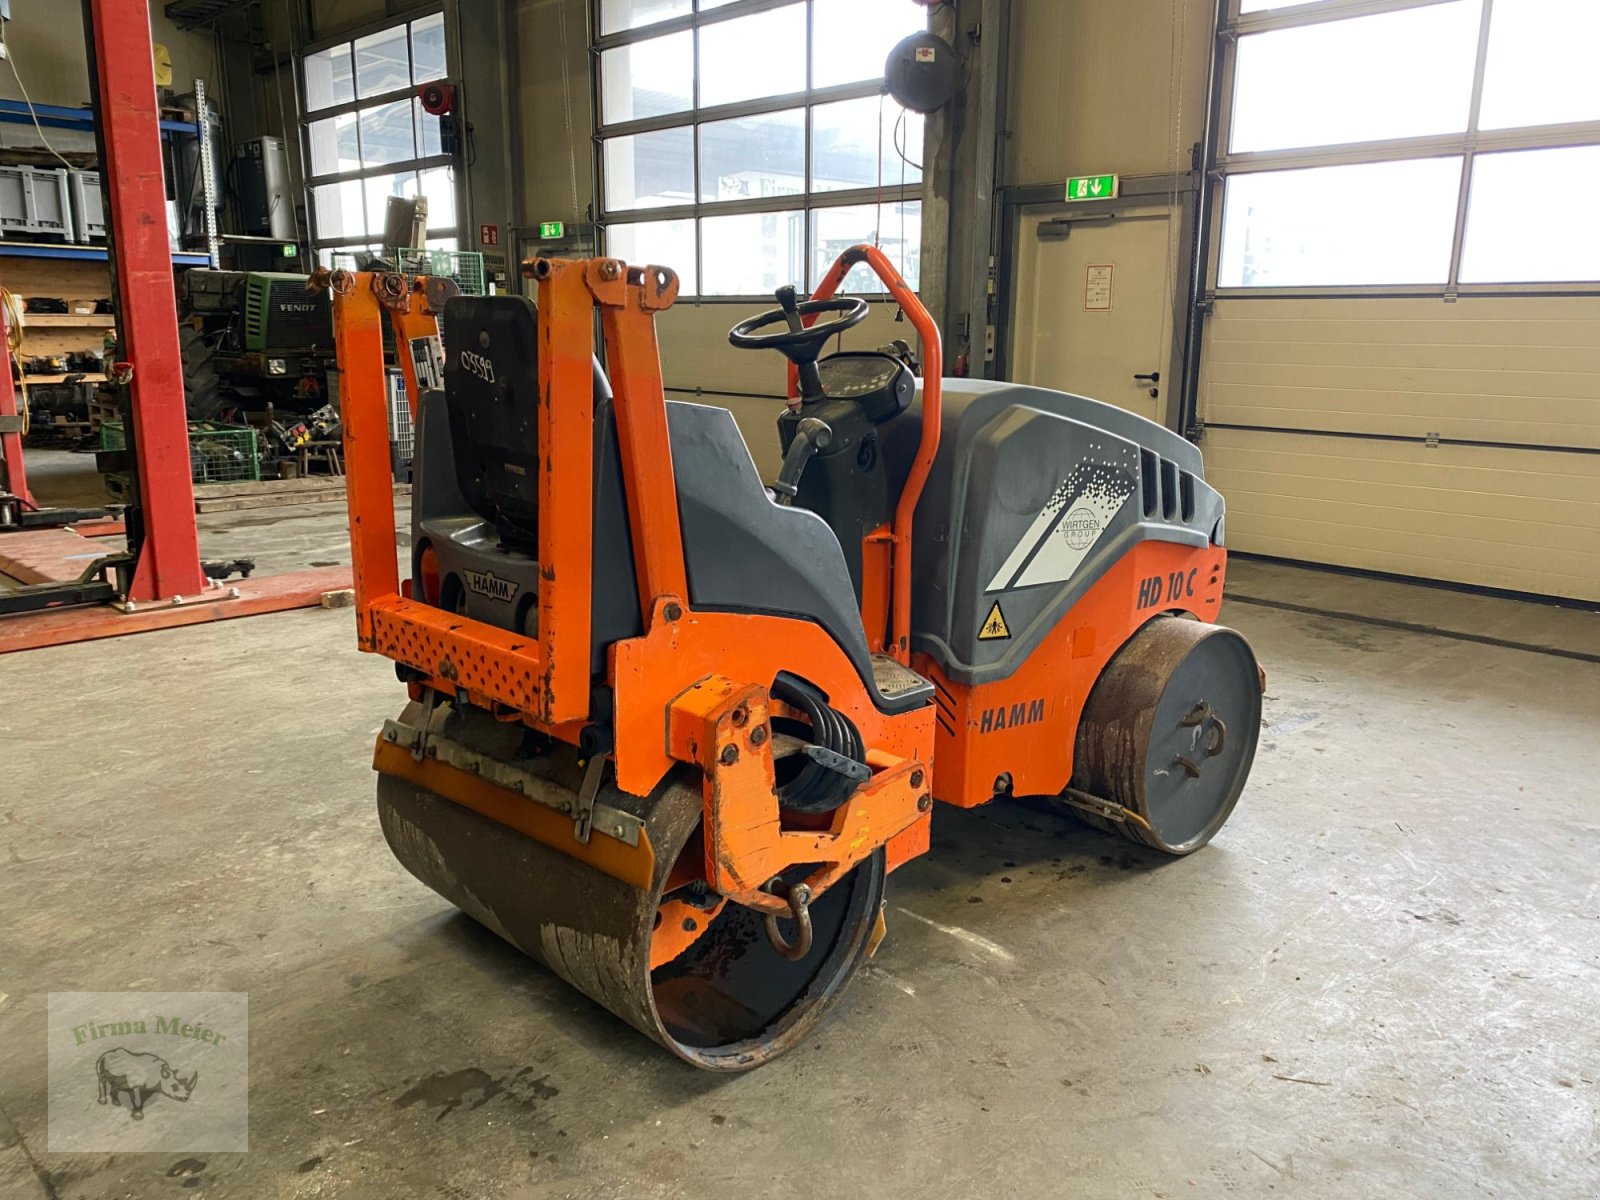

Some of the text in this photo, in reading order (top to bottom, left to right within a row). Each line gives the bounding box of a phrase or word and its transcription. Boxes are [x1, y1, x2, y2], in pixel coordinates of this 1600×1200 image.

[759, 177, 804, 197] Firm
[280, 304, 316, 312] FENDT
[1062, 519, 1100, 530] WIRTGEN
[1063, 530, 1096, 539] GROUP
[473, 575, 509, 600] HAMM
[1136, 567, 1198, 611] HD 10 C
[979, 698, 1045, 735] HAMM
